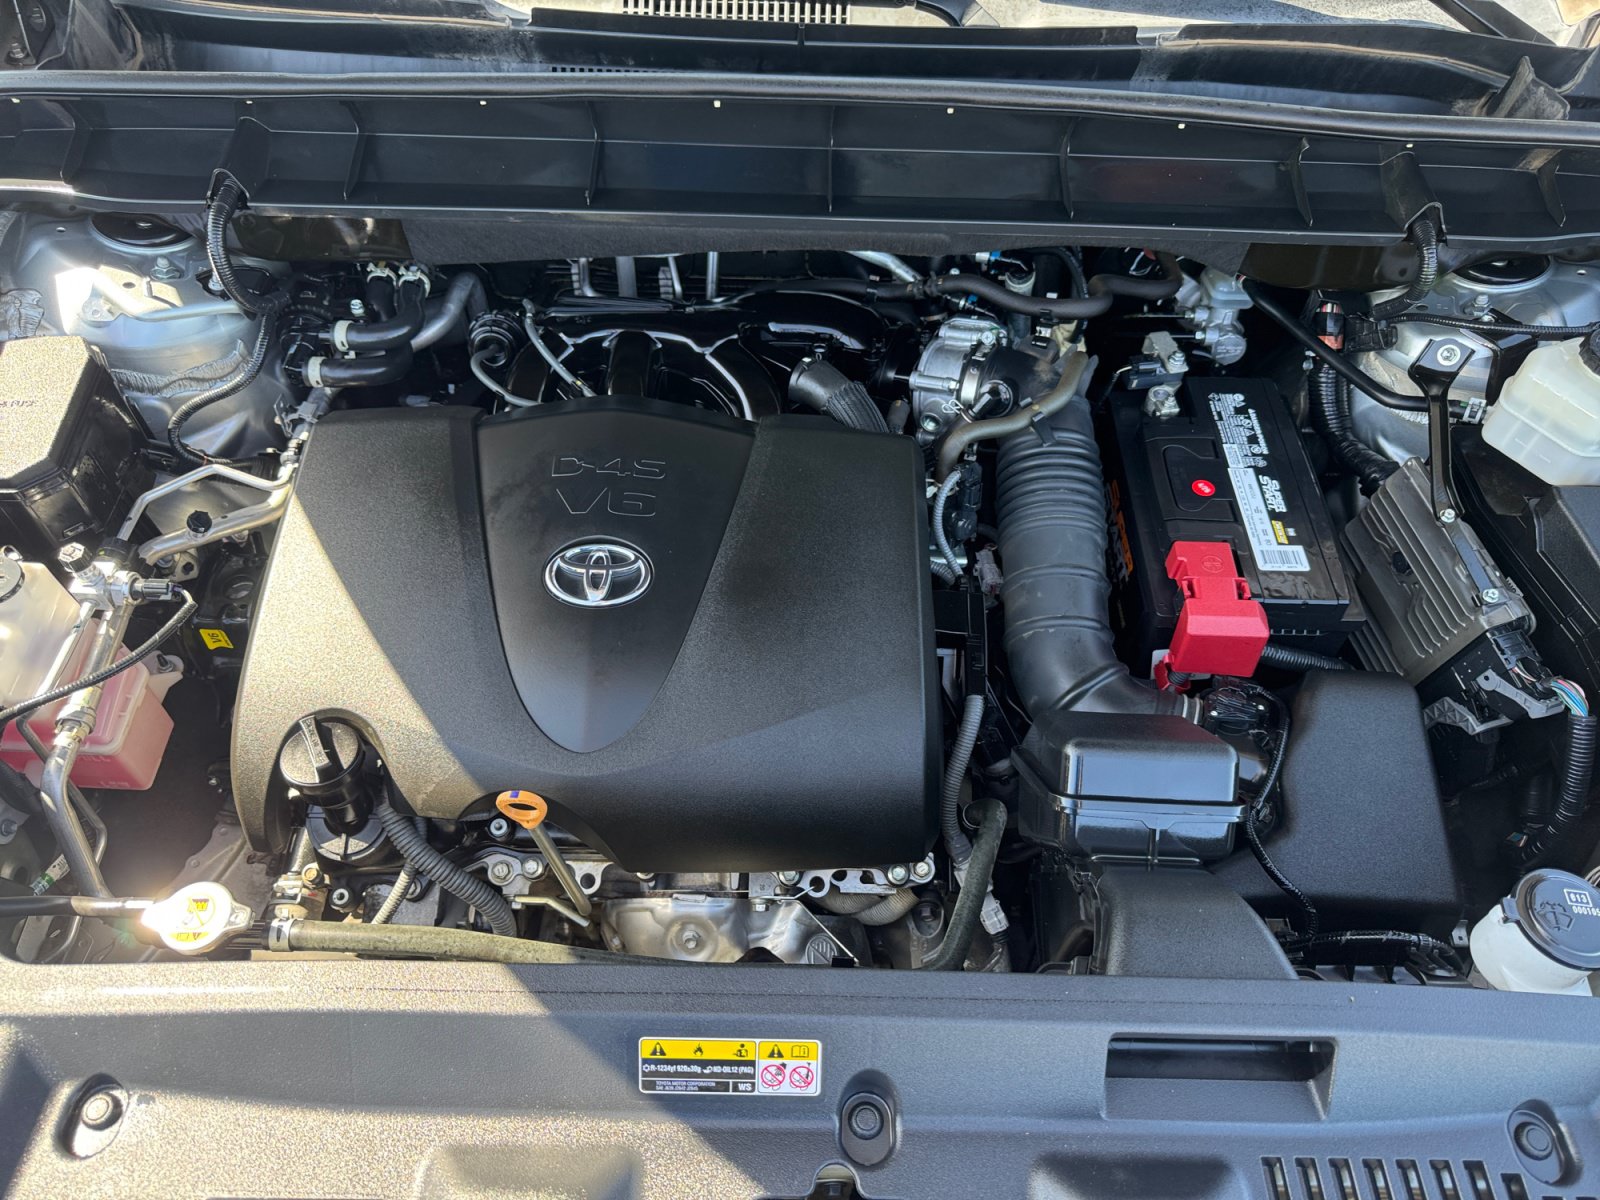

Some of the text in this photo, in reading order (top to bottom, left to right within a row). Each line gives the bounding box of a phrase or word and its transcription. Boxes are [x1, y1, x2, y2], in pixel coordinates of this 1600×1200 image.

[551, 455, 667, 480] D-4S
[555, 486, 657, 517] V6
[1258, 474, 1276, 510] START
[1270, 479, 1288, 513] SUPER
[738, 1083, 752, 1091] WS
